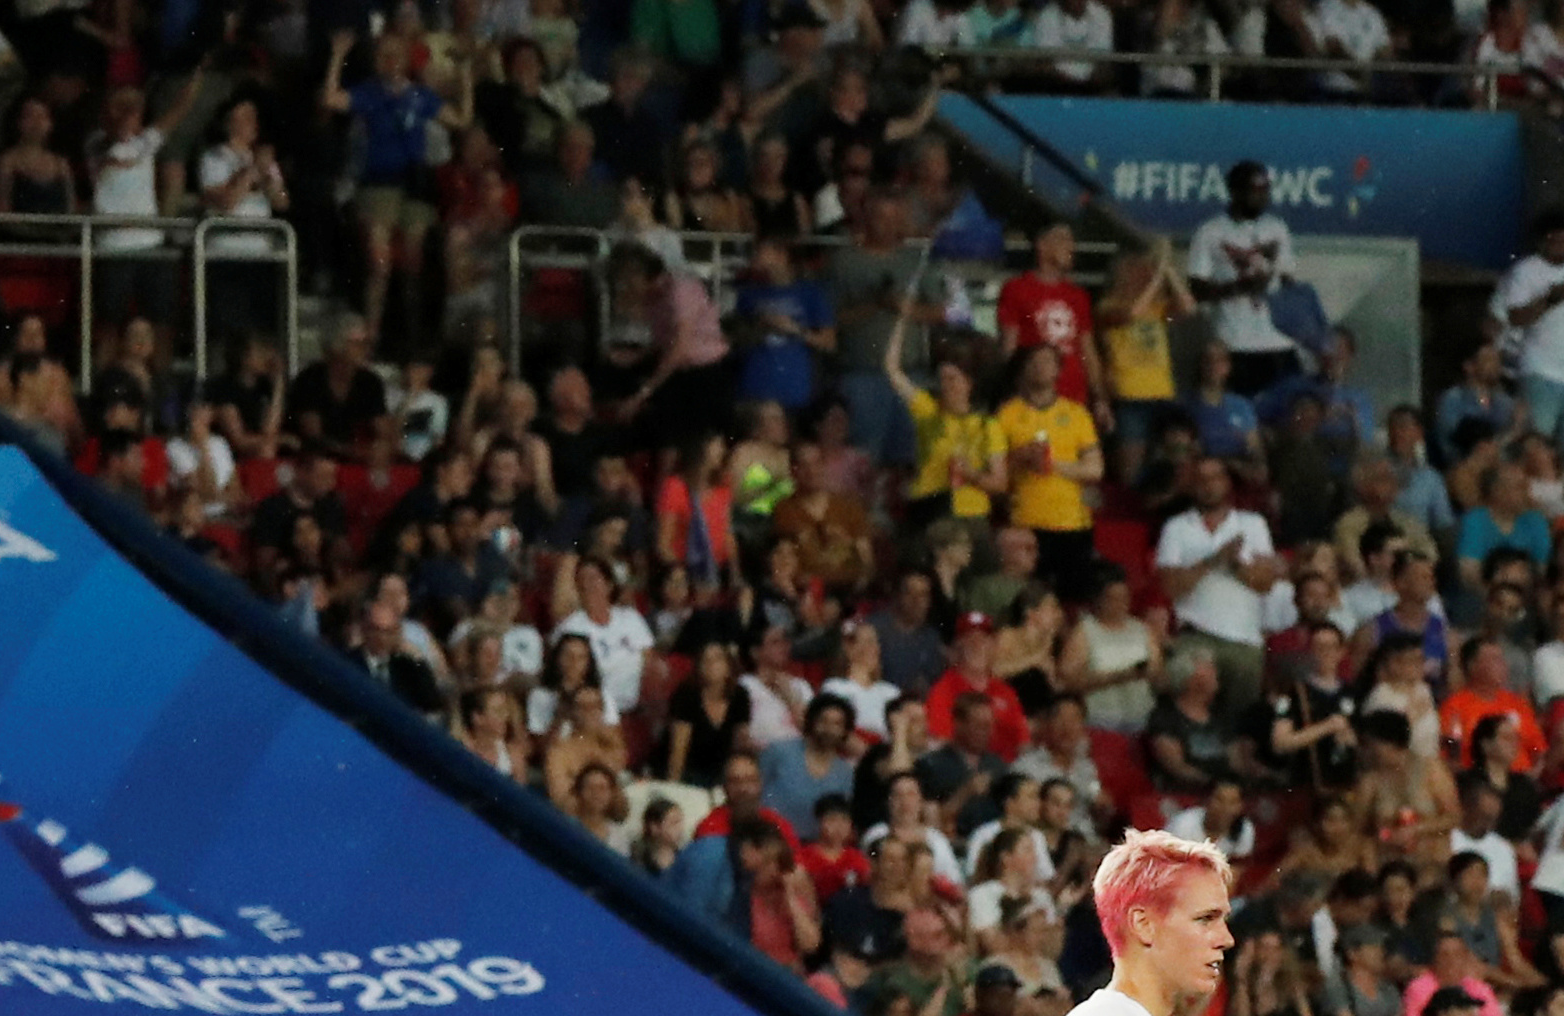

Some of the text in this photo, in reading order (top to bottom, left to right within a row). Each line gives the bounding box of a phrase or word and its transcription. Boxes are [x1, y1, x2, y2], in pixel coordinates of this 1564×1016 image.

[1112, 160, 1334, 208] #FIFAWC
[92, 912, 227, 938] FIFA
[186, 950, 361, 976] WORLD
[369, 938, 462, 967] CUP
[327, 956, 545, 1011] 2019
